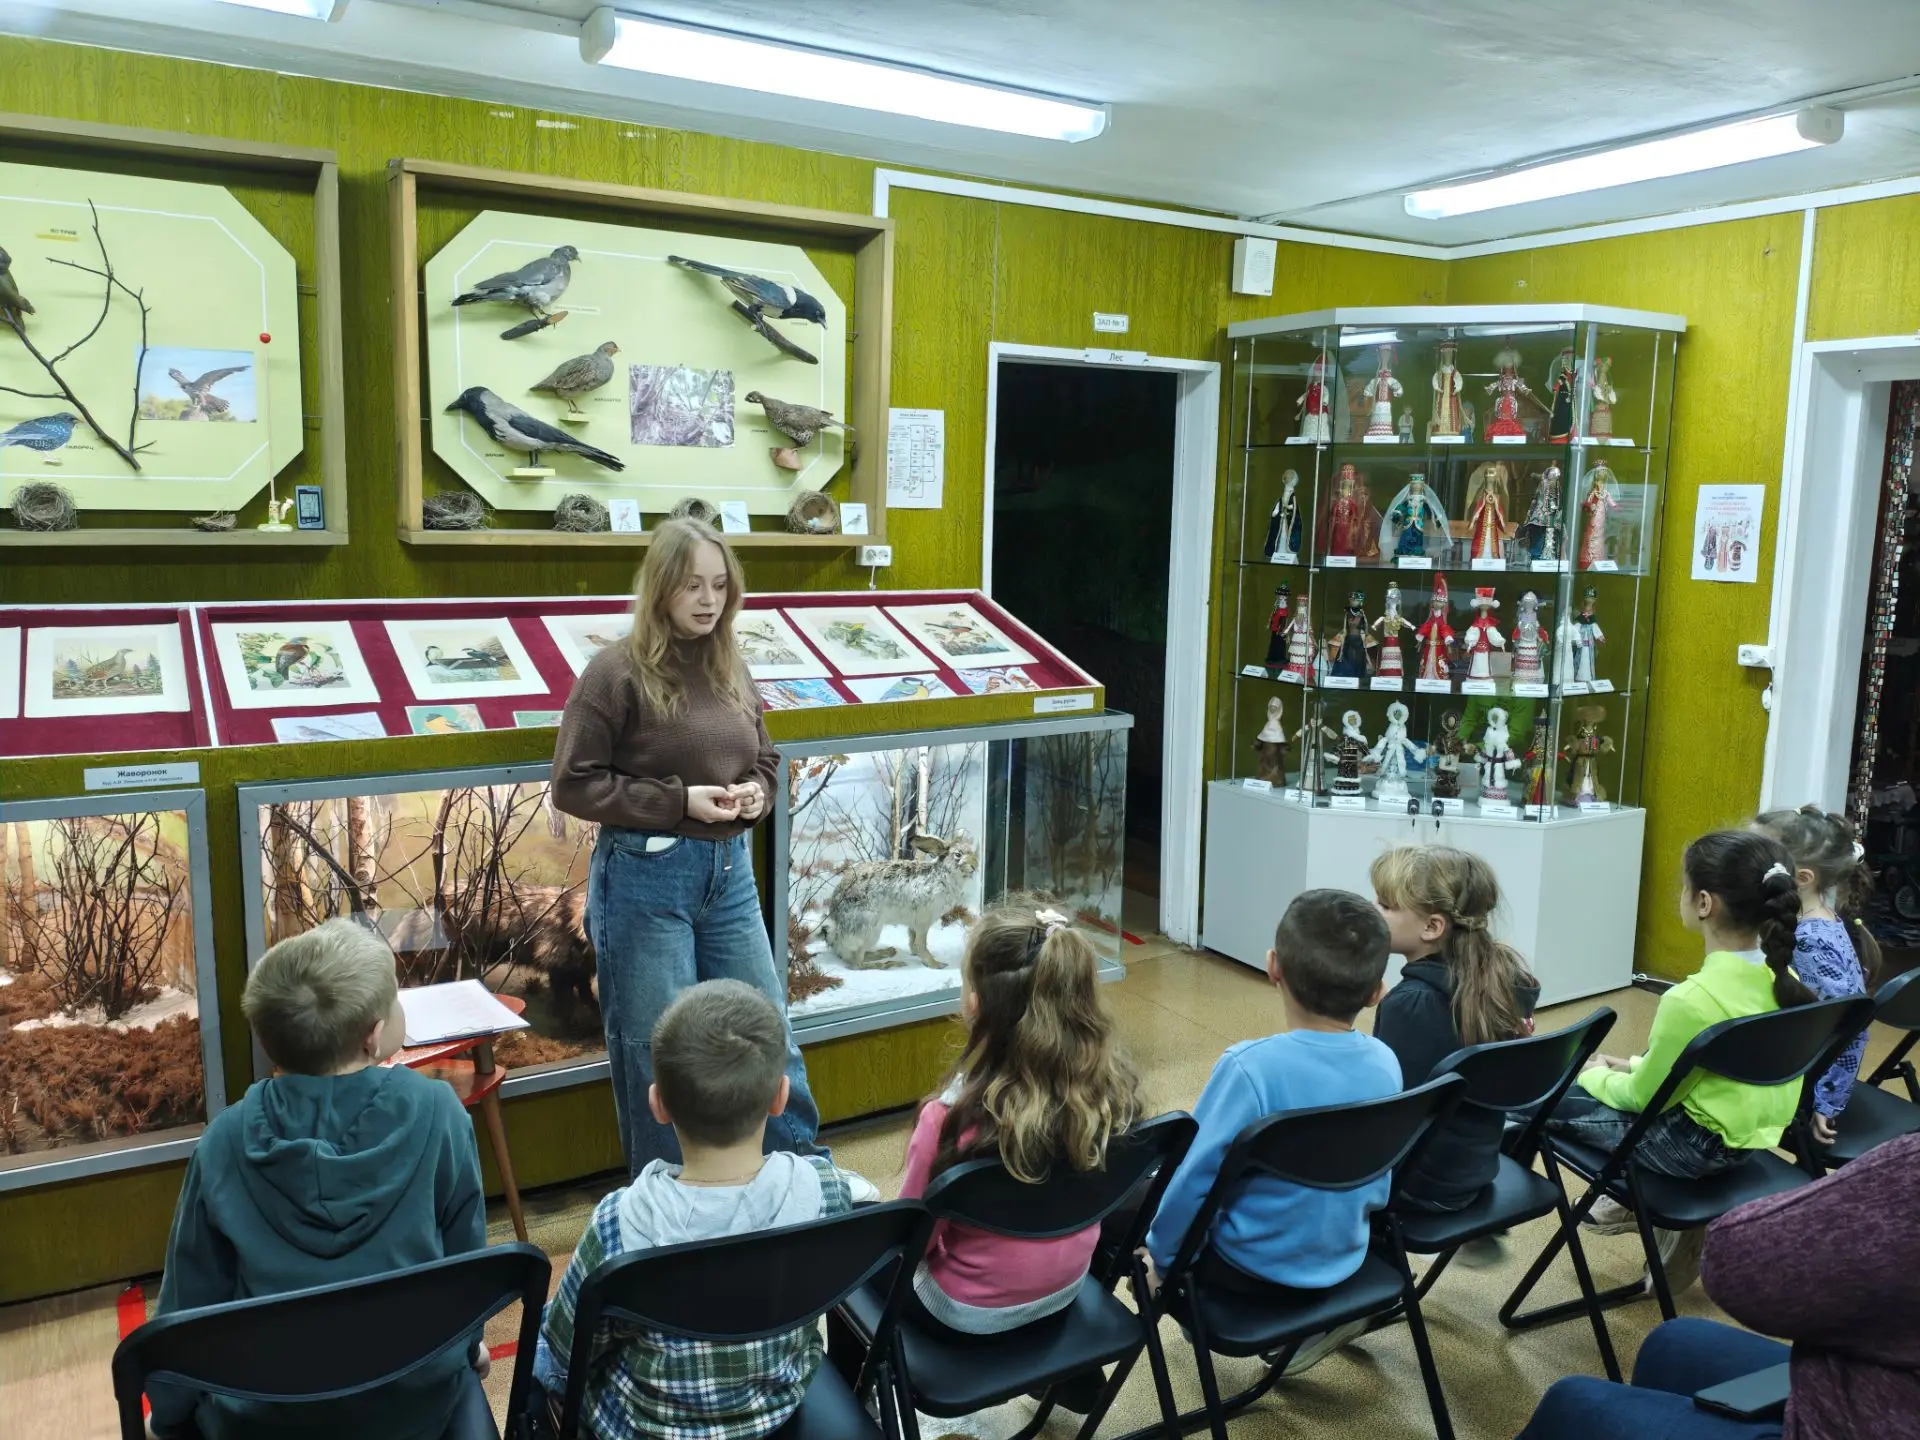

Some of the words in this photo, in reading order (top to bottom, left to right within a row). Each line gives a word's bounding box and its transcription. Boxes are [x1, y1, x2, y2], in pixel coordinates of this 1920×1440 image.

[1096, 318, 1111, 326] ЗАЛ
[1109, 352, 1124, 362] Лес
[117, 769, 168, 778] Жаворонок
